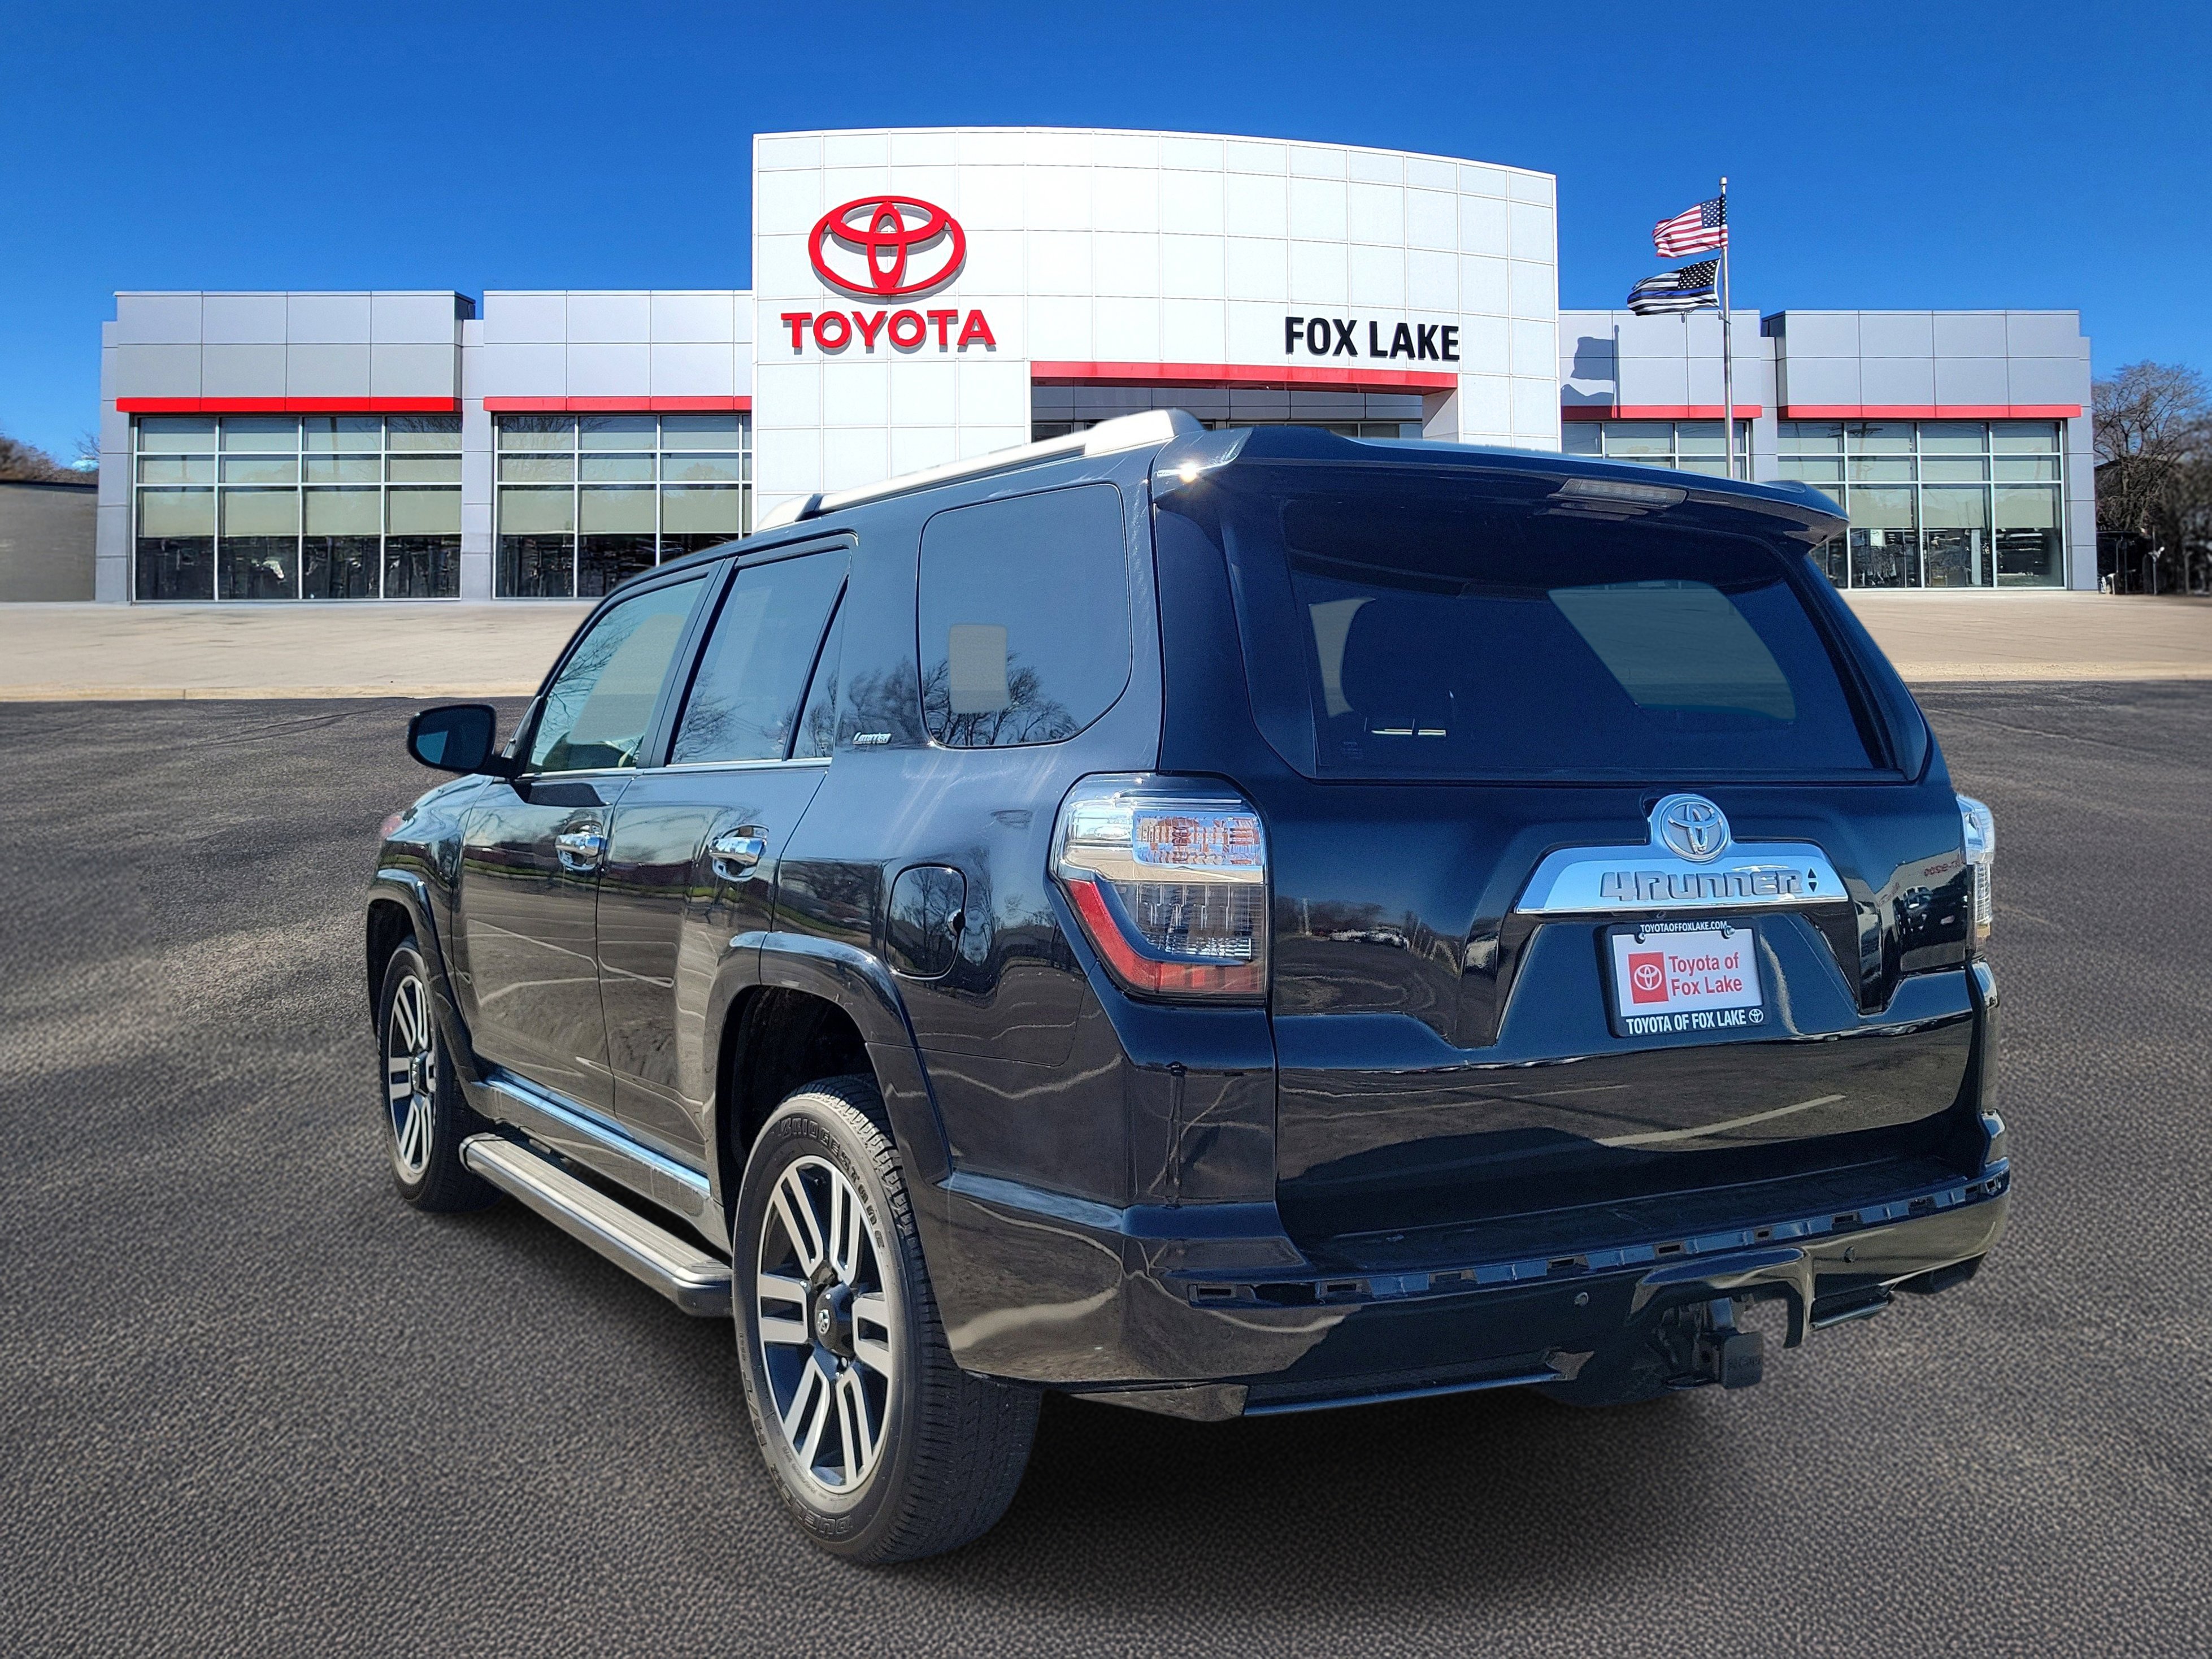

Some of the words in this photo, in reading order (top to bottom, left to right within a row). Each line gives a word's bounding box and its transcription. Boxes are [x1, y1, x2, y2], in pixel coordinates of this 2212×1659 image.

[781, 309, 997, 350] TOYOTA
[1285, 316, 1358, 357] FOX
[1370, 320, 1460, 361] LAKE
[1640, 921, 1727, 933] TOYOTAOFFOXLAKE.COM
[1668, 954, 1719, 976] Toyota
[1724, 952, 1739, 970] of
[1671, 978, 1701, 996] Fox
[1705, 975, 1742, 993] Lake
[1626, 1016, 1672, 1034] TOYOTA
[1674, 1014, 1689, 1031] OF
[1692, 1011, 1715, 1029] FOX
[1716, 1009, 1746, 1026] LAKE
